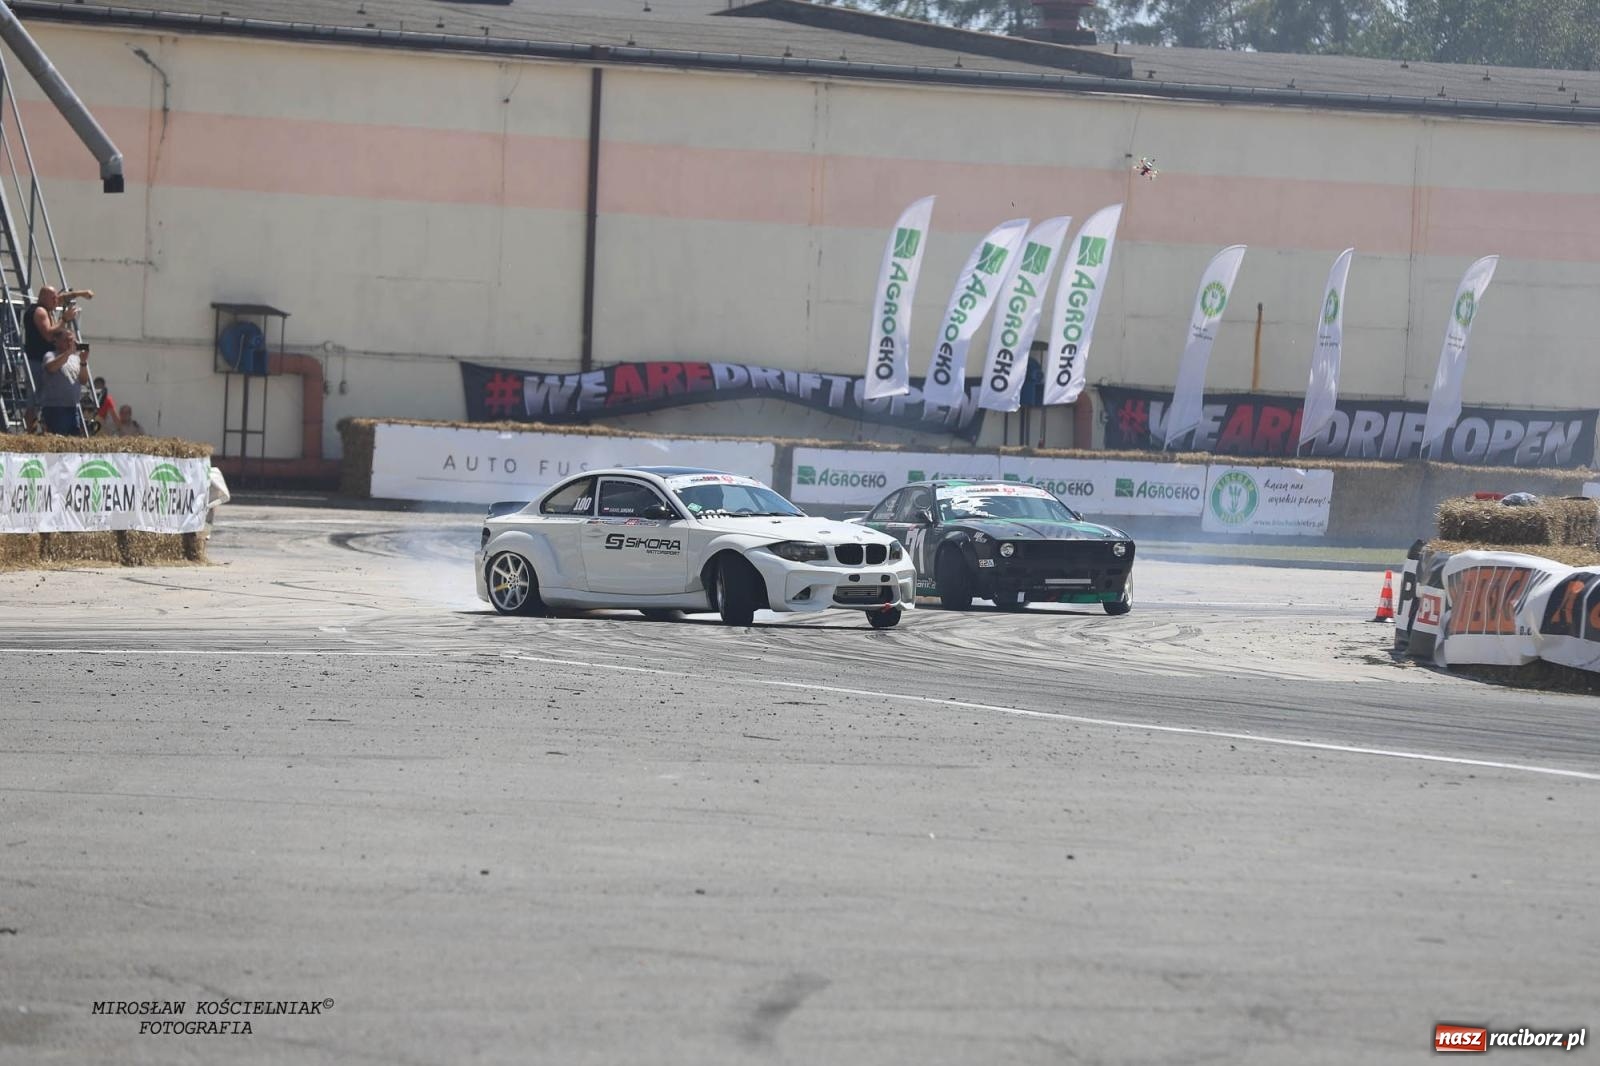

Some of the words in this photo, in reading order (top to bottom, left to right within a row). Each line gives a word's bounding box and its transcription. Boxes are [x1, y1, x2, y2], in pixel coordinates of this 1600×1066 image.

[875, 260, 909, 381] AGROEKO
[933, 273, 988, 387] AGROEKO
[990, 273, 1037, 393] AGROEKO
[1056, 270, 1096, 388] AGROEKO
[443, 455, 517, 473] AUTO
[818, 467, 887, 488] AGROEKO
[1136, 479, 1200, 501] AGROEKO
[573, 496, 592, 510] 100
